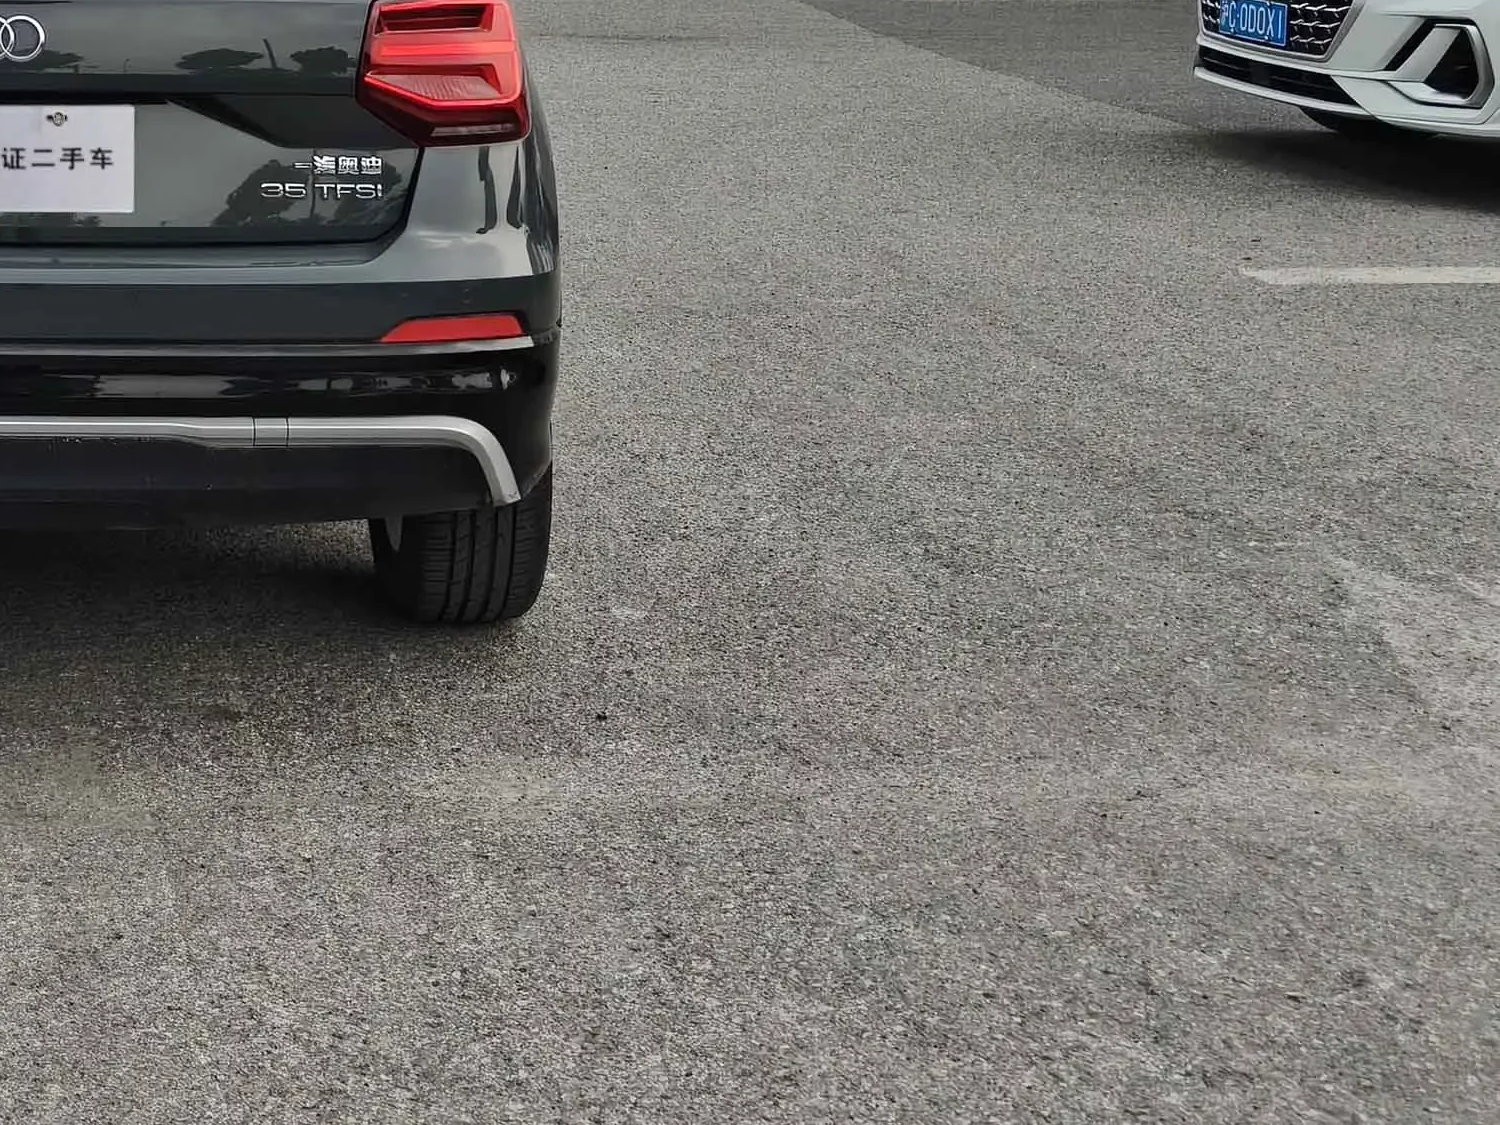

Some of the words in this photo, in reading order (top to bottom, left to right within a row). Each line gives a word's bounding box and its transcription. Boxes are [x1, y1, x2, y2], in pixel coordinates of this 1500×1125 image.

[293, 155, 382, 175] 一汽奥迪
[260, 182, 307, 198] 35
[314, 183, 382, 199] TFSI
